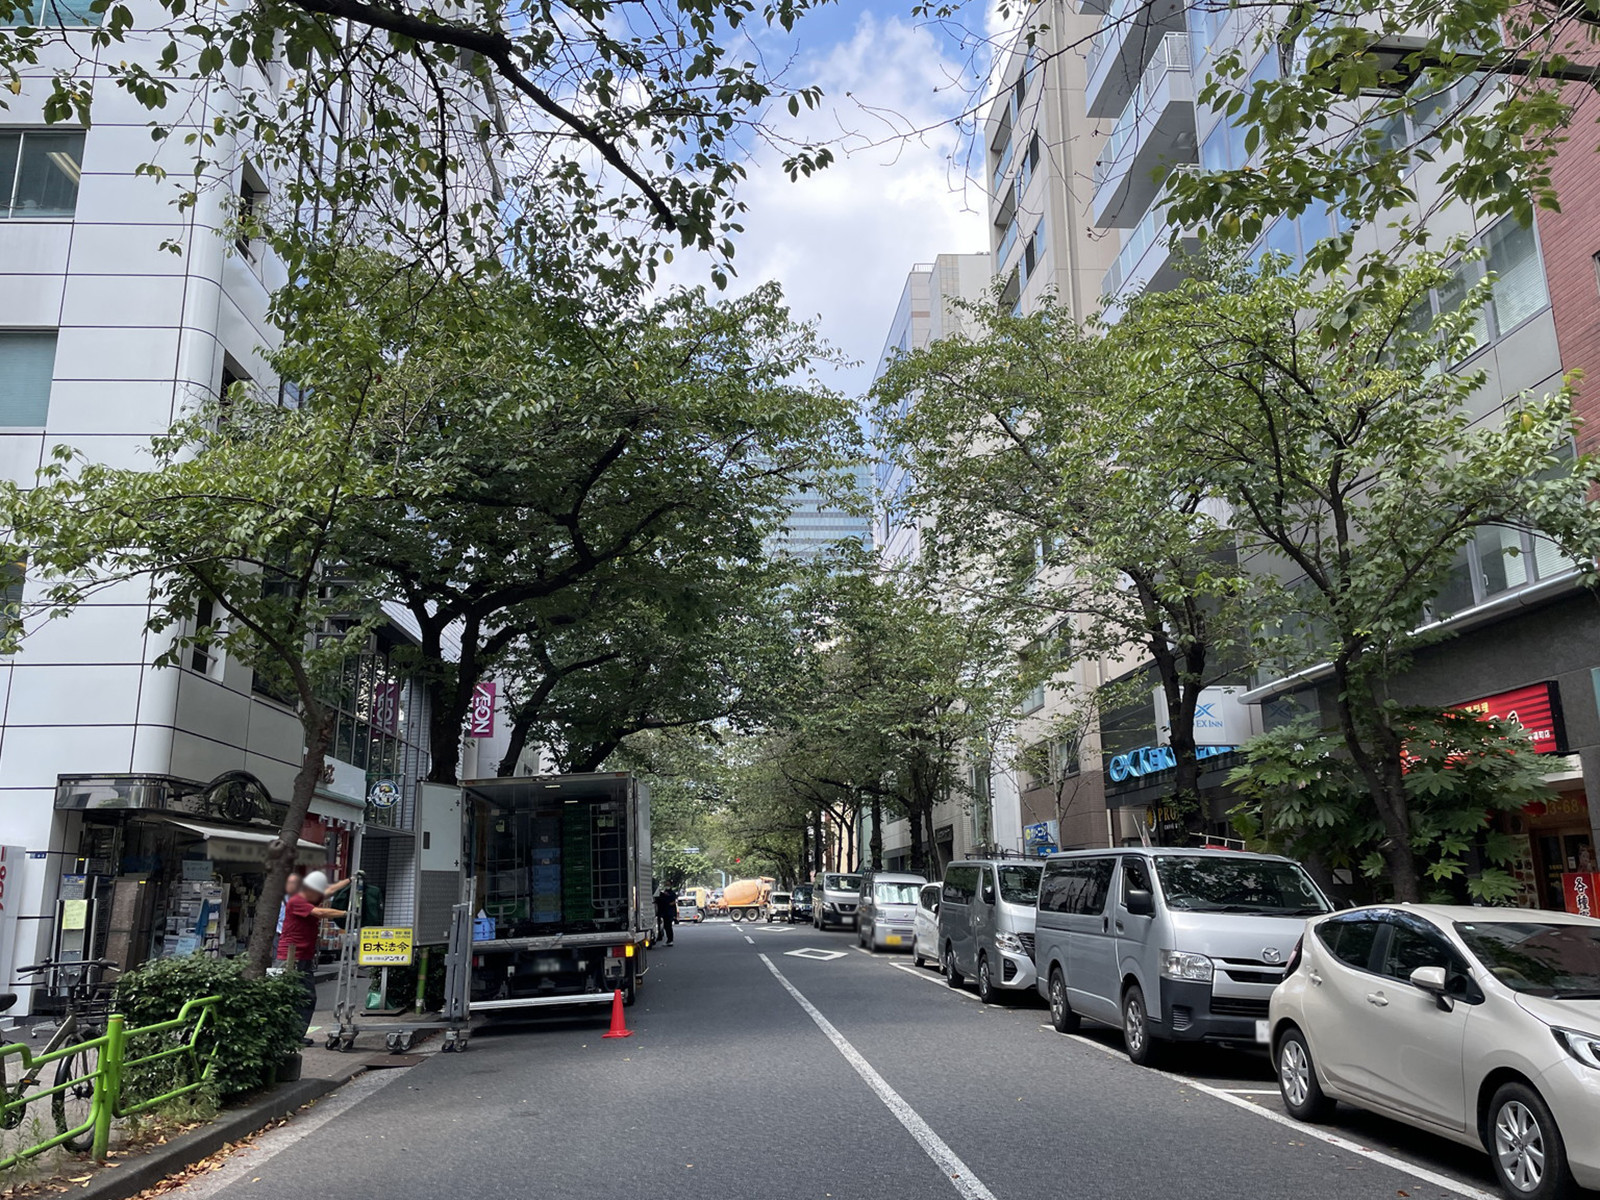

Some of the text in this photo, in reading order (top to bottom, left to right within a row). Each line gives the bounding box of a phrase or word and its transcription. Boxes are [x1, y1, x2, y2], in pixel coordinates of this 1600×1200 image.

[474, 685, 491, 733] AEON
[1196, 720, 1207, 728] EX
[363, 941, 409, 952] 日本法令
